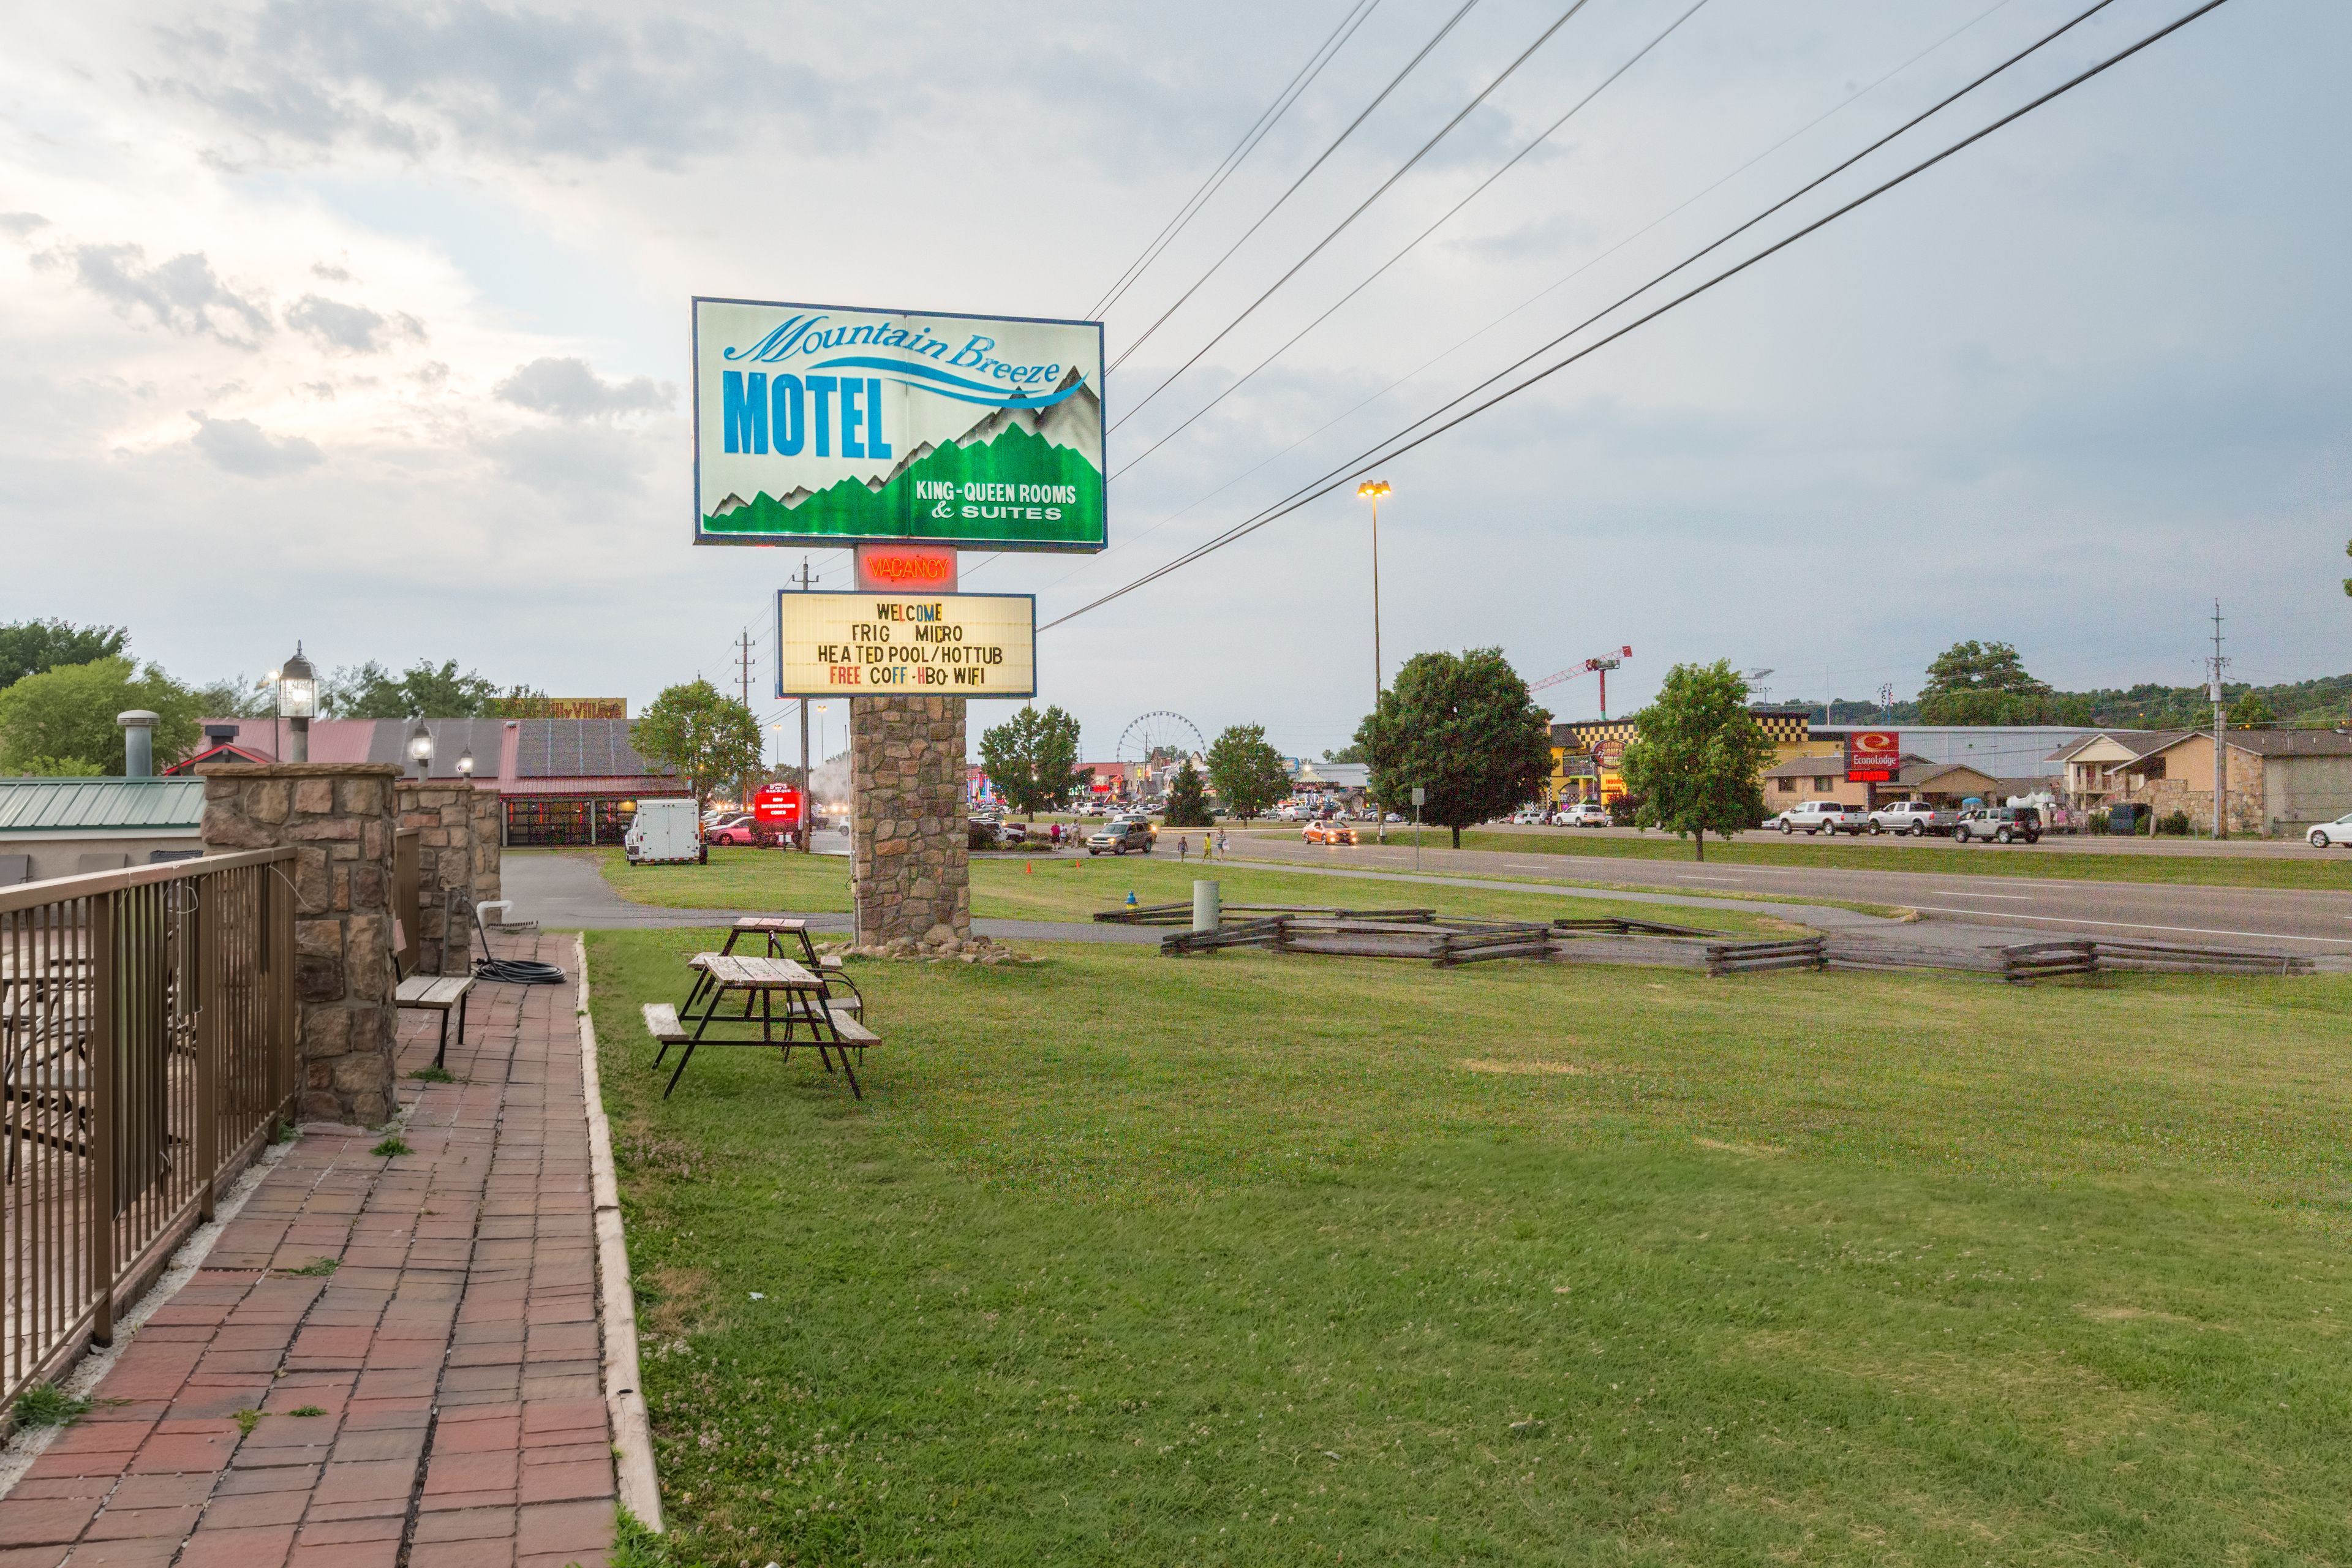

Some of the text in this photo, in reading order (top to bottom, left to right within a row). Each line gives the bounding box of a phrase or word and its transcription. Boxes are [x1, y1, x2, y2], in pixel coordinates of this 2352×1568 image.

[723, 314, 1060, 385] Mountain Breeze
[723, 371, 891, 459] MOTEL
[916, 481, 1076, 505] KING-QUEEN ROOMS
[932, 500, 1062, 521] & SUITES
[869, 558, 949, 578] VACANCY
[877, 603, 942, 622] WELCOME
[852, 624, 962, 643] FRIG MICRO
[818, 645, 884, 665] HEATED
[829, 666, 861, 685] FREE
[870, 666, 907, 684] COFF
[954, 667, 984, 685] WIFI
[1853, 755, 1896, 766] EconoLodge
